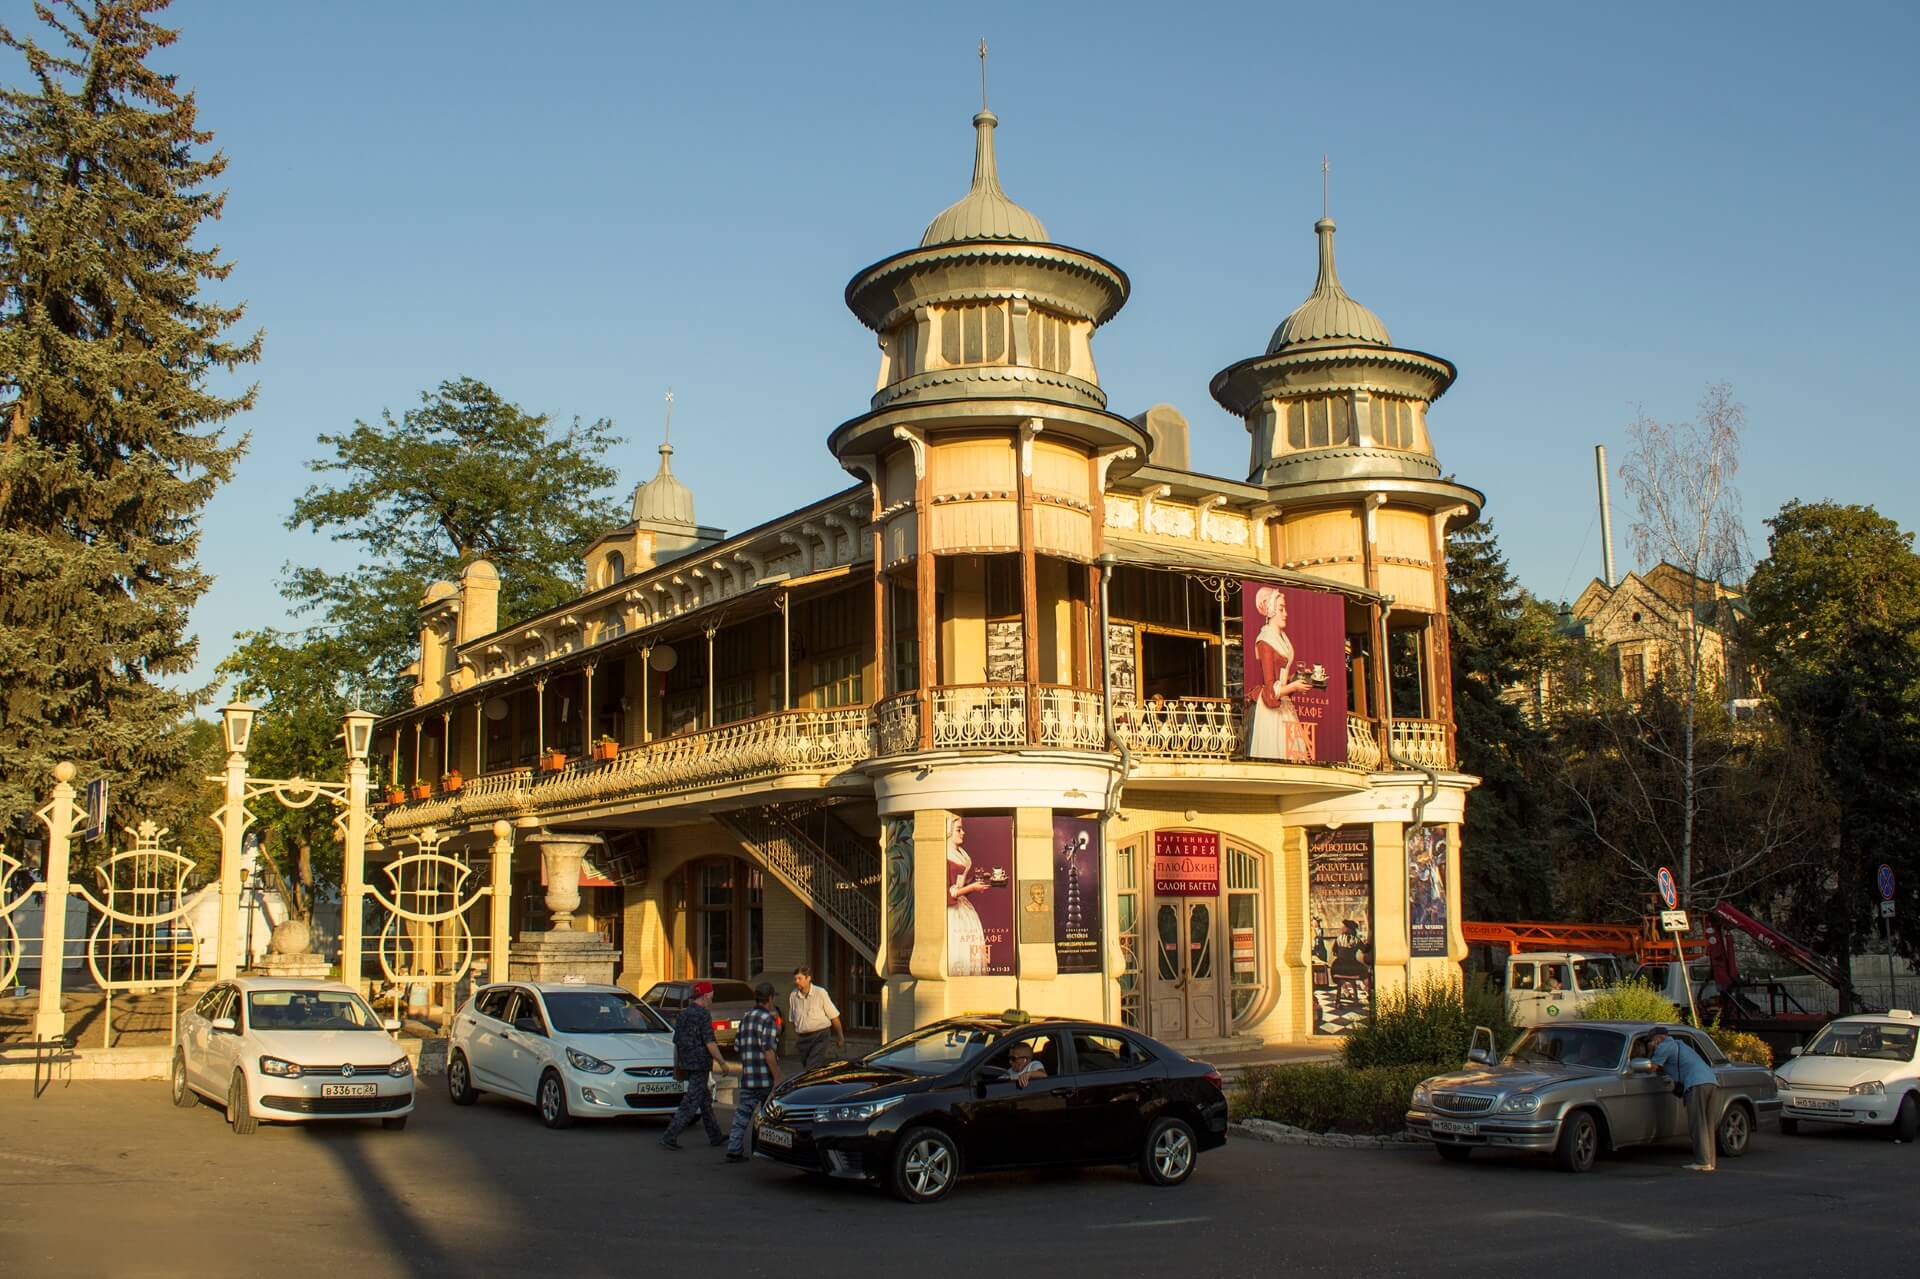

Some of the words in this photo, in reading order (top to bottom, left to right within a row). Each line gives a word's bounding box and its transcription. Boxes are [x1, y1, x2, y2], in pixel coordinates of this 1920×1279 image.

[1156, 835, 1216, 844] КАРТИННАЯ
[1156, 844, 1216, 856] ГАЛЕРЕЯ
[1310, 842, 1369, 852] ЖИВОПИСЬ
[1316, 862, 1364, 872] АКВАРЕЛИ
[1316, 872, 1363, 882] ПАСТЕЛИ
[1157, 881, 1186, 891] САЛОН
[1188, 882, 1217, 891] БАГЕТА
